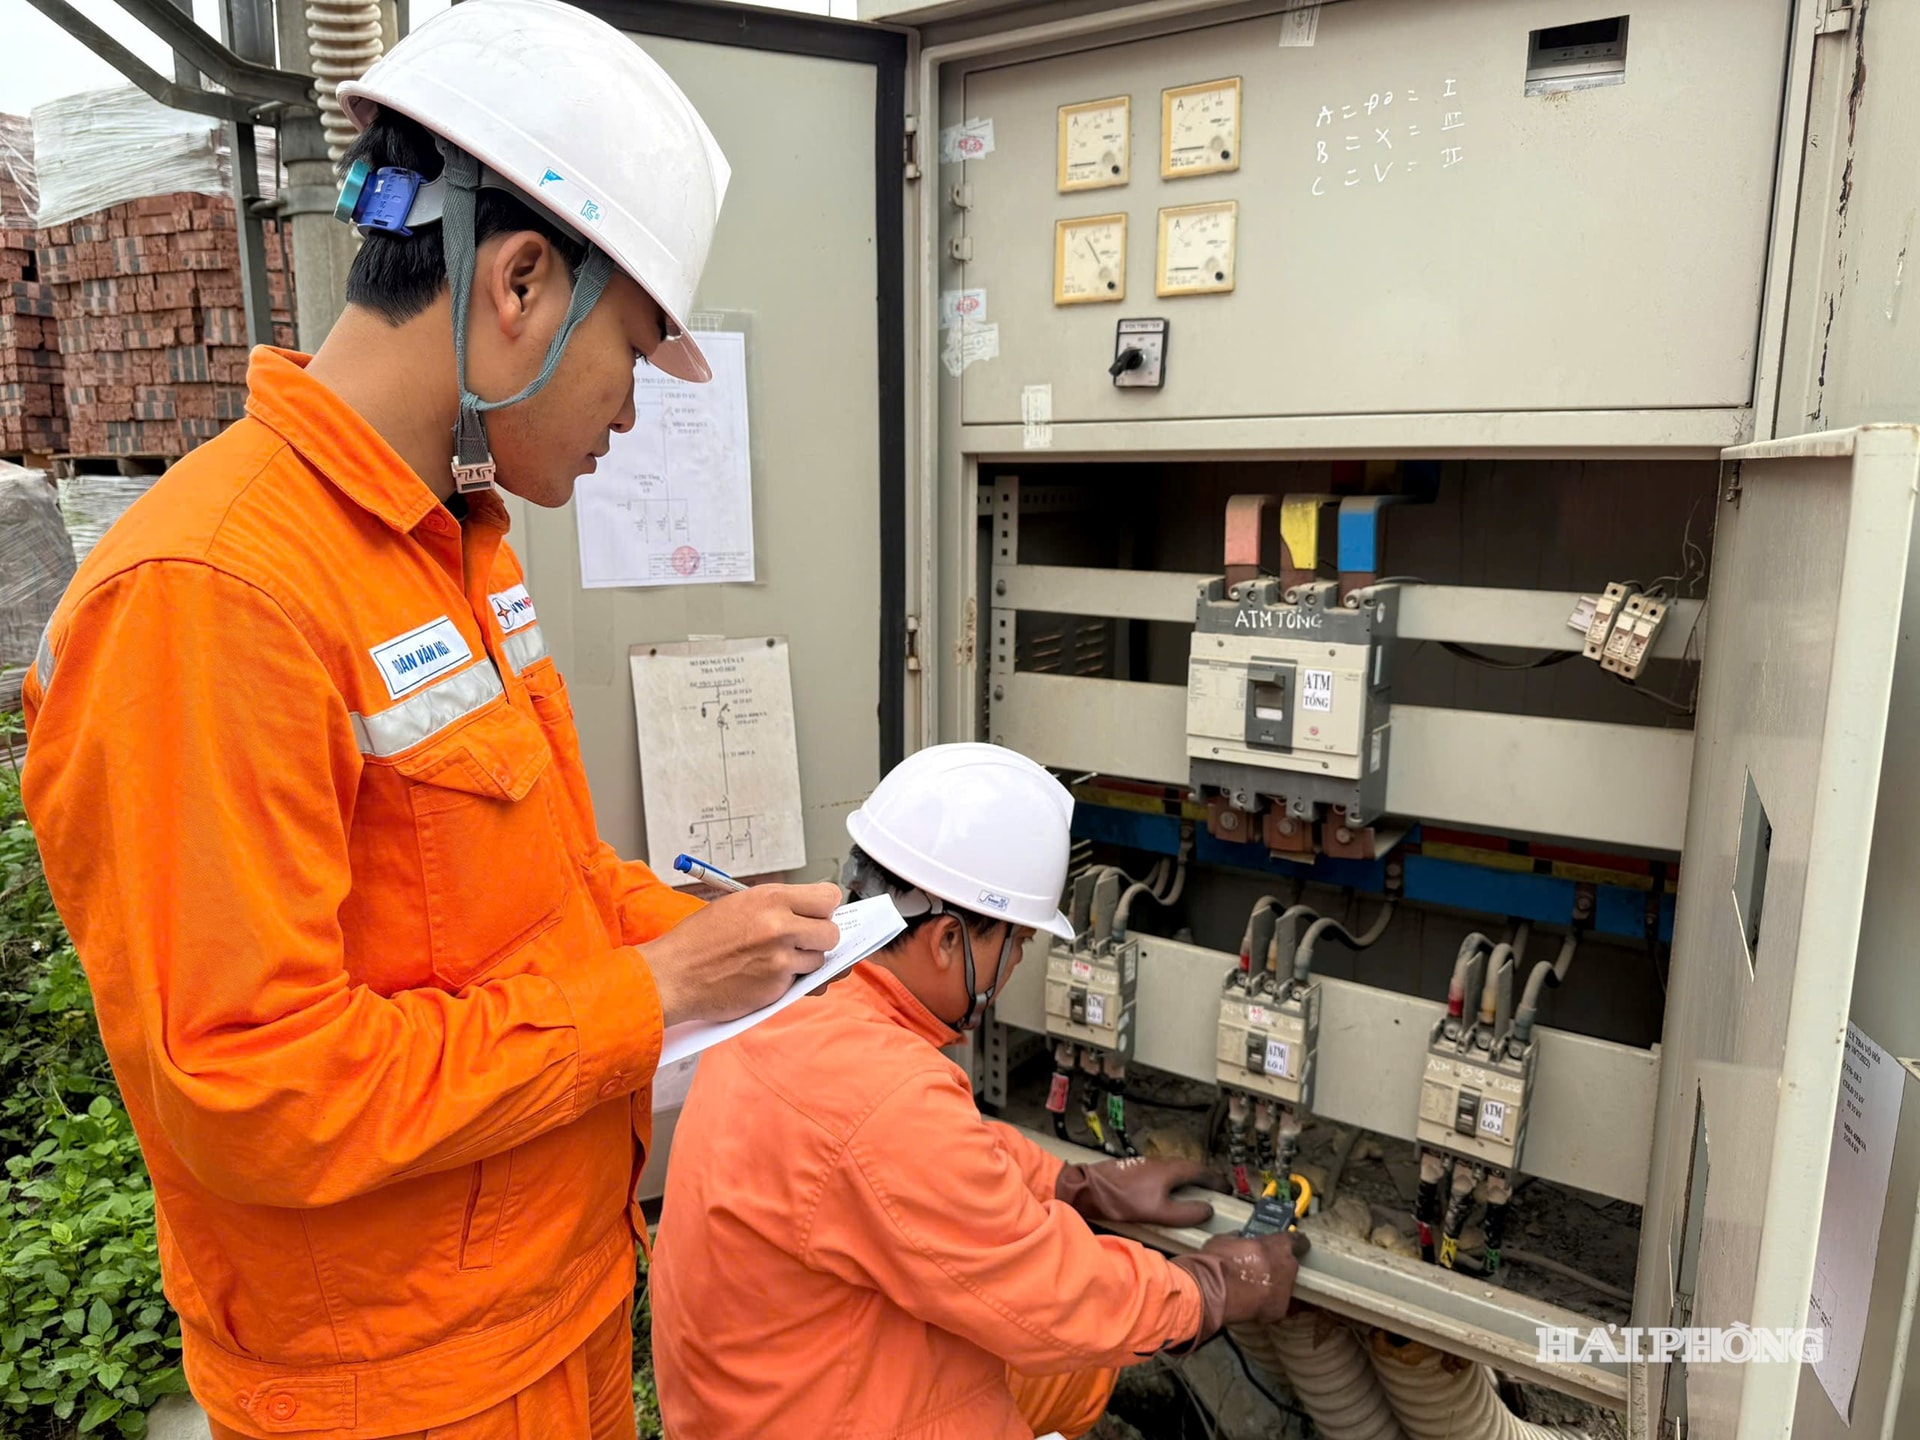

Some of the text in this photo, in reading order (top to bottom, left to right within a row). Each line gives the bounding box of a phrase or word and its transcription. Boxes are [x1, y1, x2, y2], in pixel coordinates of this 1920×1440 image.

[1315, 105, 1334, 127] A
[1316, 140, 1329, 164] B
[1311, 176, 1326, 196] C
[1234, 609, 1273, 629] ATM
[415, 643, 437, 665] VĂN
[1304, 673, 1331, 691] ATM
[1484, 1103, 1502, 1118] ATM
